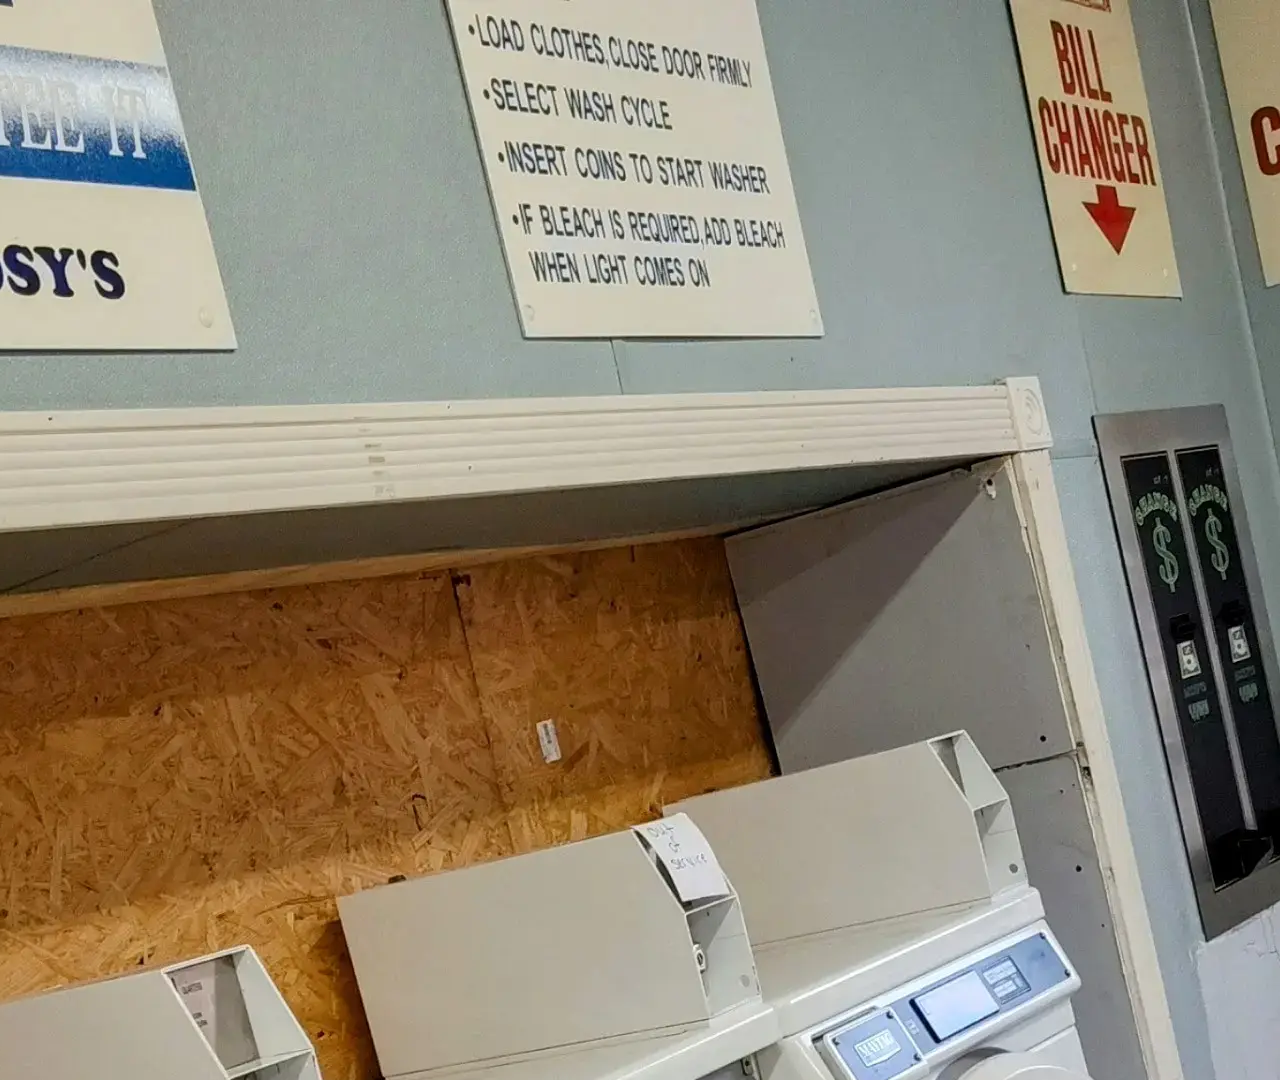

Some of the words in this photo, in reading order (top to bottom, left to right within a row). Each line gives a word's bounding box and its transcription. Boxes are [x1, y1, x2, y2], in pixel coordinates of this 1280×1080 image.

[475, 14, 526, 52] LOAD
[608, 37, 659, 74] CLOSE
[662, 46, 705, 81] DOOR
[708, 54, 753, 89] FIRMLY
[1050, 19, 1113, 103] BILL
[90, 85, 148, 160] IT
[490, 78, 559, 117] SELECT
[564, 88, 617, 124] WASH
[620, 96, 673, 131] CYCLE
[504, 140, 568, 177] INSERT
[574, 149, 626, 183] COINS
[629, 153, 654, 185] TO
[657, 157, 704, 190] START
[708, 161, 771, 195] WASHER
[1038, 96, 1157, 187] CHANGER
[518, 203, 534, 236] IF
[540, 205, 606, 240] BLEACH
[608, 211, 625, 241] IS
[704, 217, 732, 247] ADD
[736, 220, 786, 249] BLEACH
[528, 251, 582, 284] WHEN
[584, 253, 629, 285] LIGHT
[634, 256, 685, 287] COMES
[688, 259, 711, 288] ON
